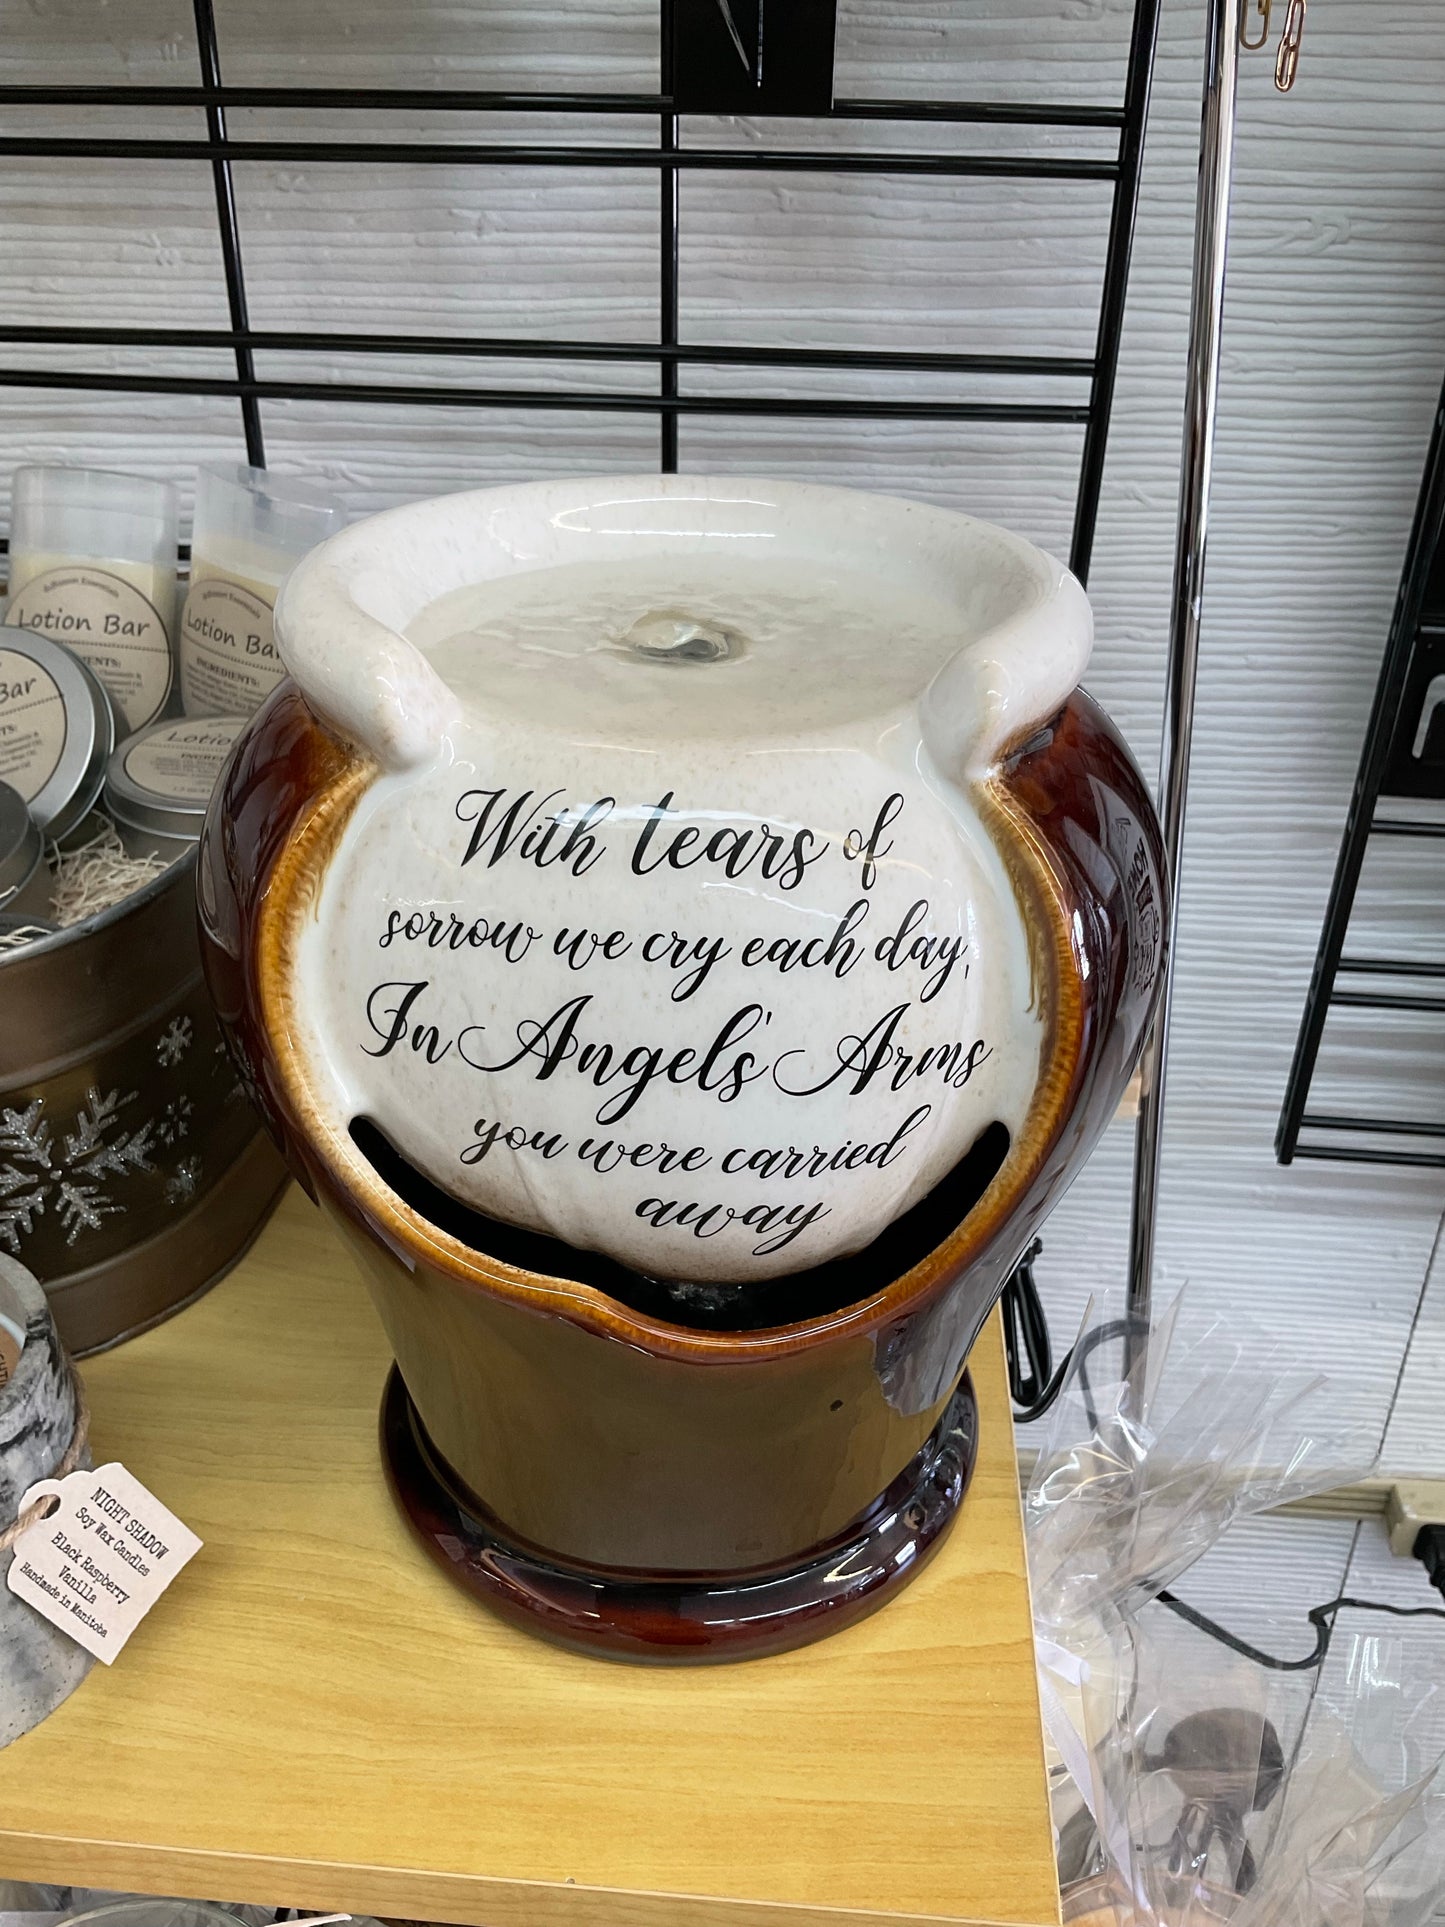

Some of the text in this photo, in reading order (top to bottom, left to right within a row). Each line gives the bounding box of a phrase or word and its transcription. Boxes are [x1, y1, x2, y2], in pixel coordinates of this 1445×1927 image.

[18, 608, 151, 637] Lotion Bar
[187, 608, 236, 648] Lotion
[456, 788, 905, 891] With tears of
[378, 899, 971, 1003] sorrow we cry each day,
[360, 982, 994, 1126] In Angels' Arms
[460, 1104, 933, 1179] you were carried
[634, 1197, 834, 1256] away
[75, 1506, 151, 1577] Soy Wax Candles
[90, 1487, 170, 1560] NIGHT SHADOW
[19, 1562, 109, 1638] Handmade in Manitoba
[51, 1531, 130, 1605] Black Raspberry
[58, 1565, 98, 1605] Vanilla
